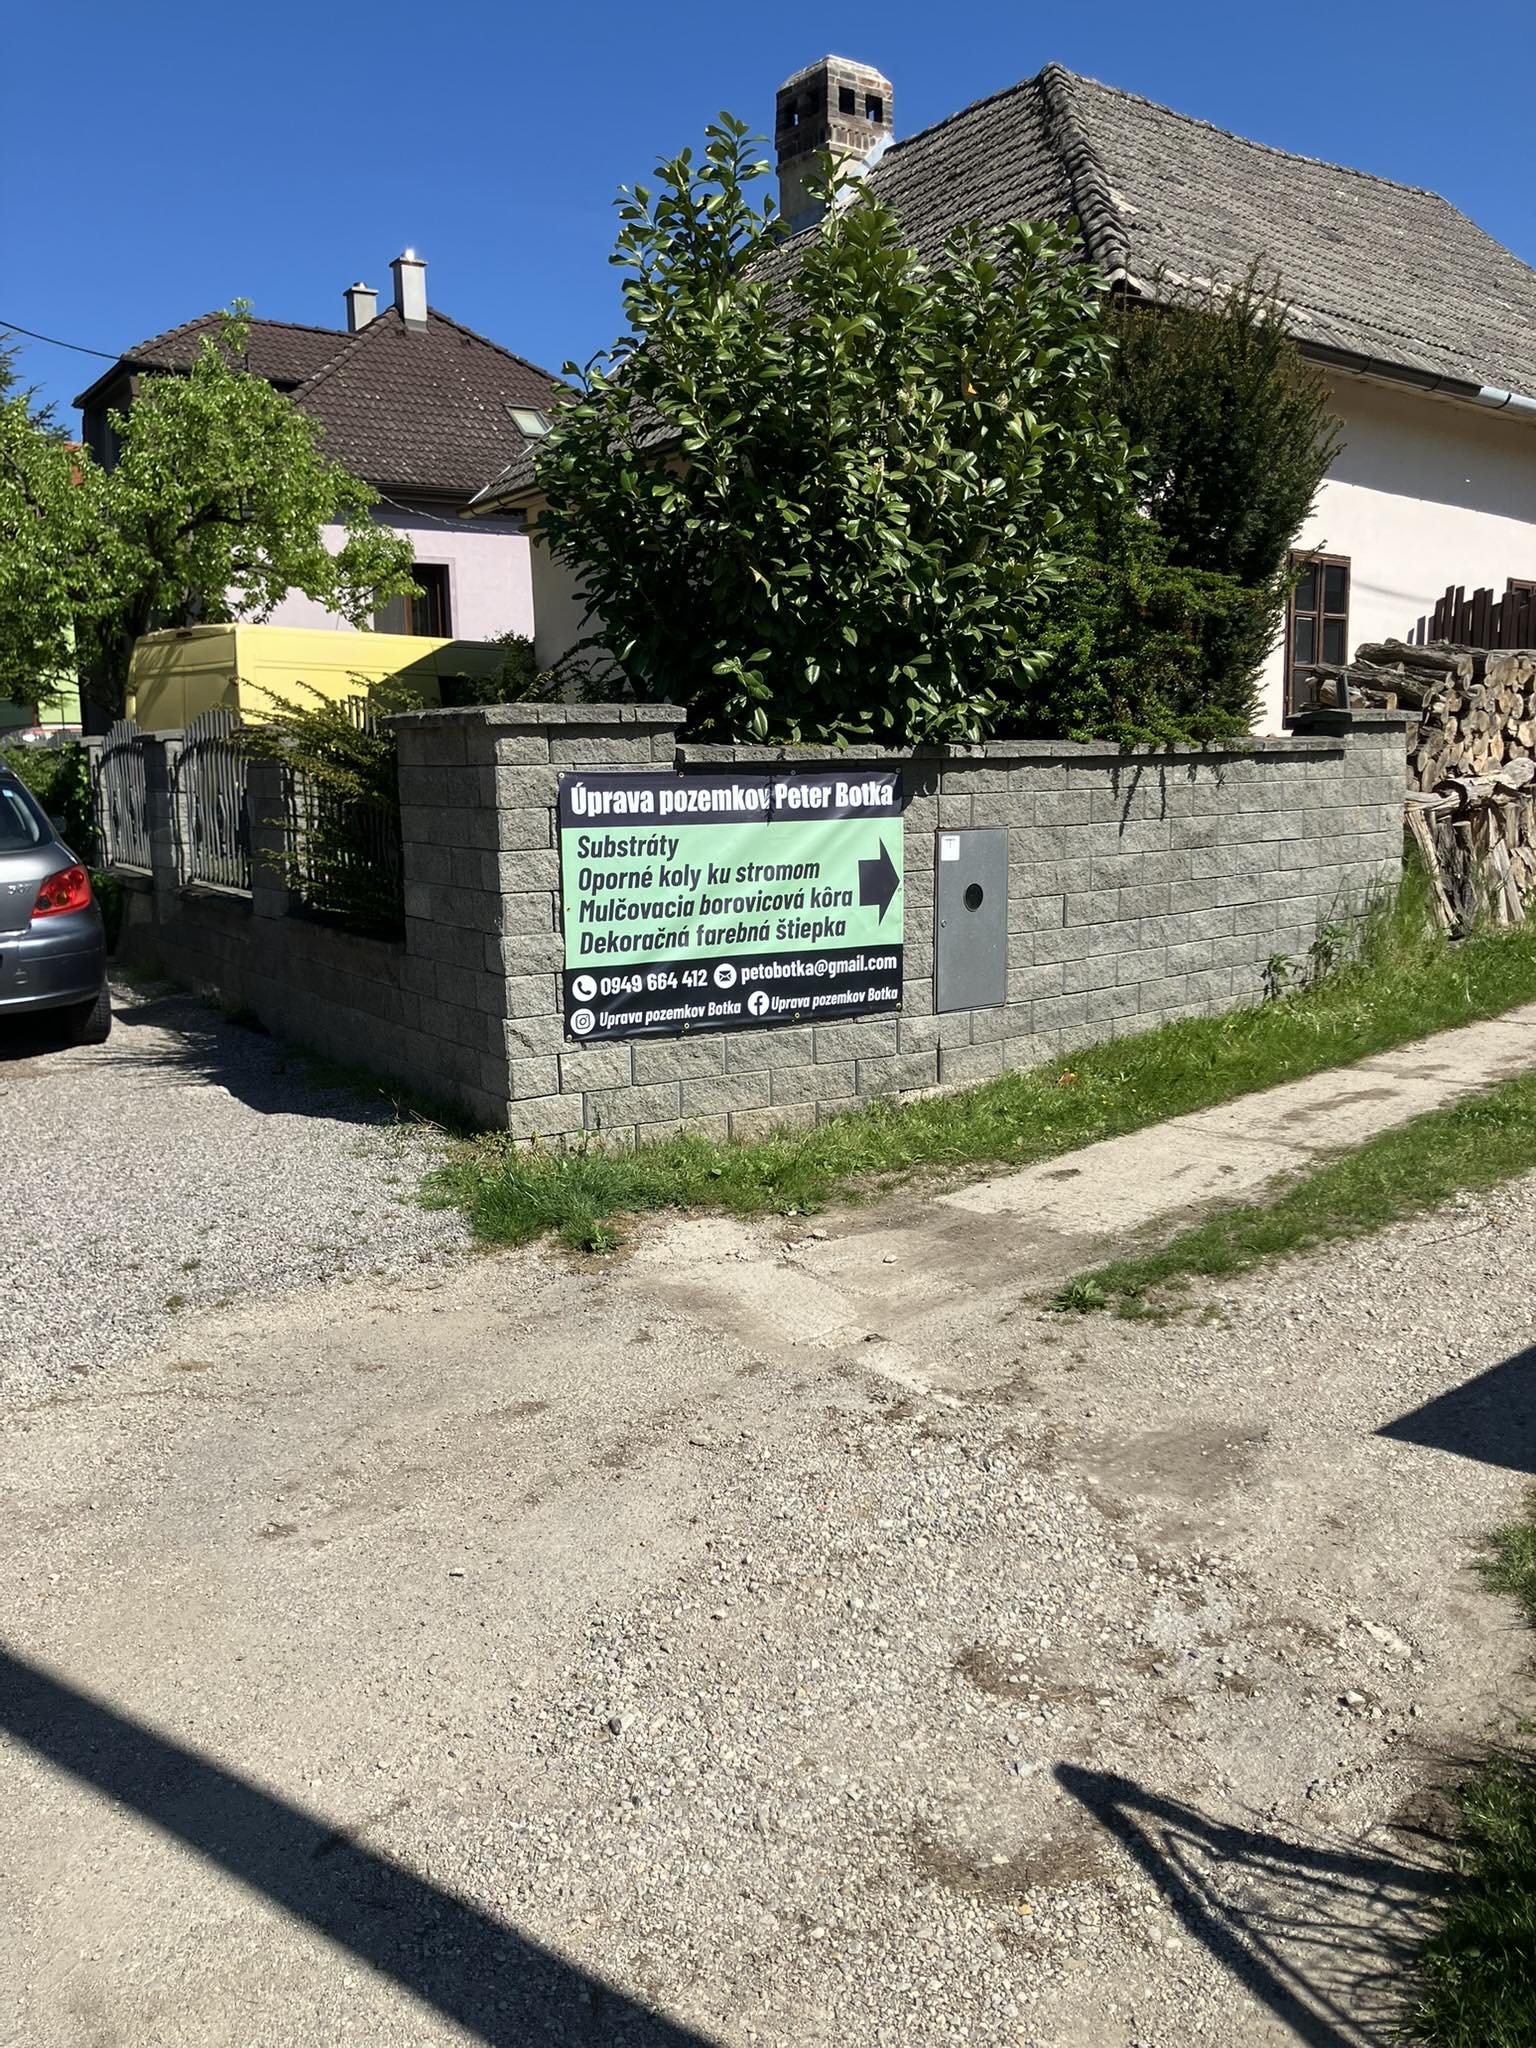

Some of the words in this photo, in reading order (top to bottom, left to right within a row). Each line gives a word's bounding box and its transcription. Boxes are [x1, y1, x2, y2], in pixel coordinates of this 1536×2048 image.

[570, 781, 654, 817] Úprava
[659, 784, 770, 816] pozemkov
[774, 782, 832, 810] Peter
[835, 781, 894, 808] Botka
[577, 833, 680, 862] Substráty
[578, 865, 653, 896] Oporné
[658, 863, 702, 892] koly
[707, 862, 731, 885] ku
[735, 862, 820, 883] stromom
[578, 894, 695, 923] Mulčovacia
[699, 887, 805, 916] borovicová
[810, 886, 853, 909] kôra
[579, 925, 690, 955] Dekoračná
[696, 919, 770, 946] farebná
[775, 916, 846, 944] štiepka
[600, 974, 643, 996] 0949
[646, 971, 678, 991] 664
[681, 969, 708, 988] 412
[741, 954, 898, 985] petobotka@gmail.com
[599, 1010, 642, 1029] Uprava
[645, 1003, 705, 1026] pozemkov
[707, 1000, 742, 1017] Botka
[771, 995, 810, 1013] Uprava
[811, 990, 866, 1010] pozemkov
[867, 986, 898, 1001] Botka
